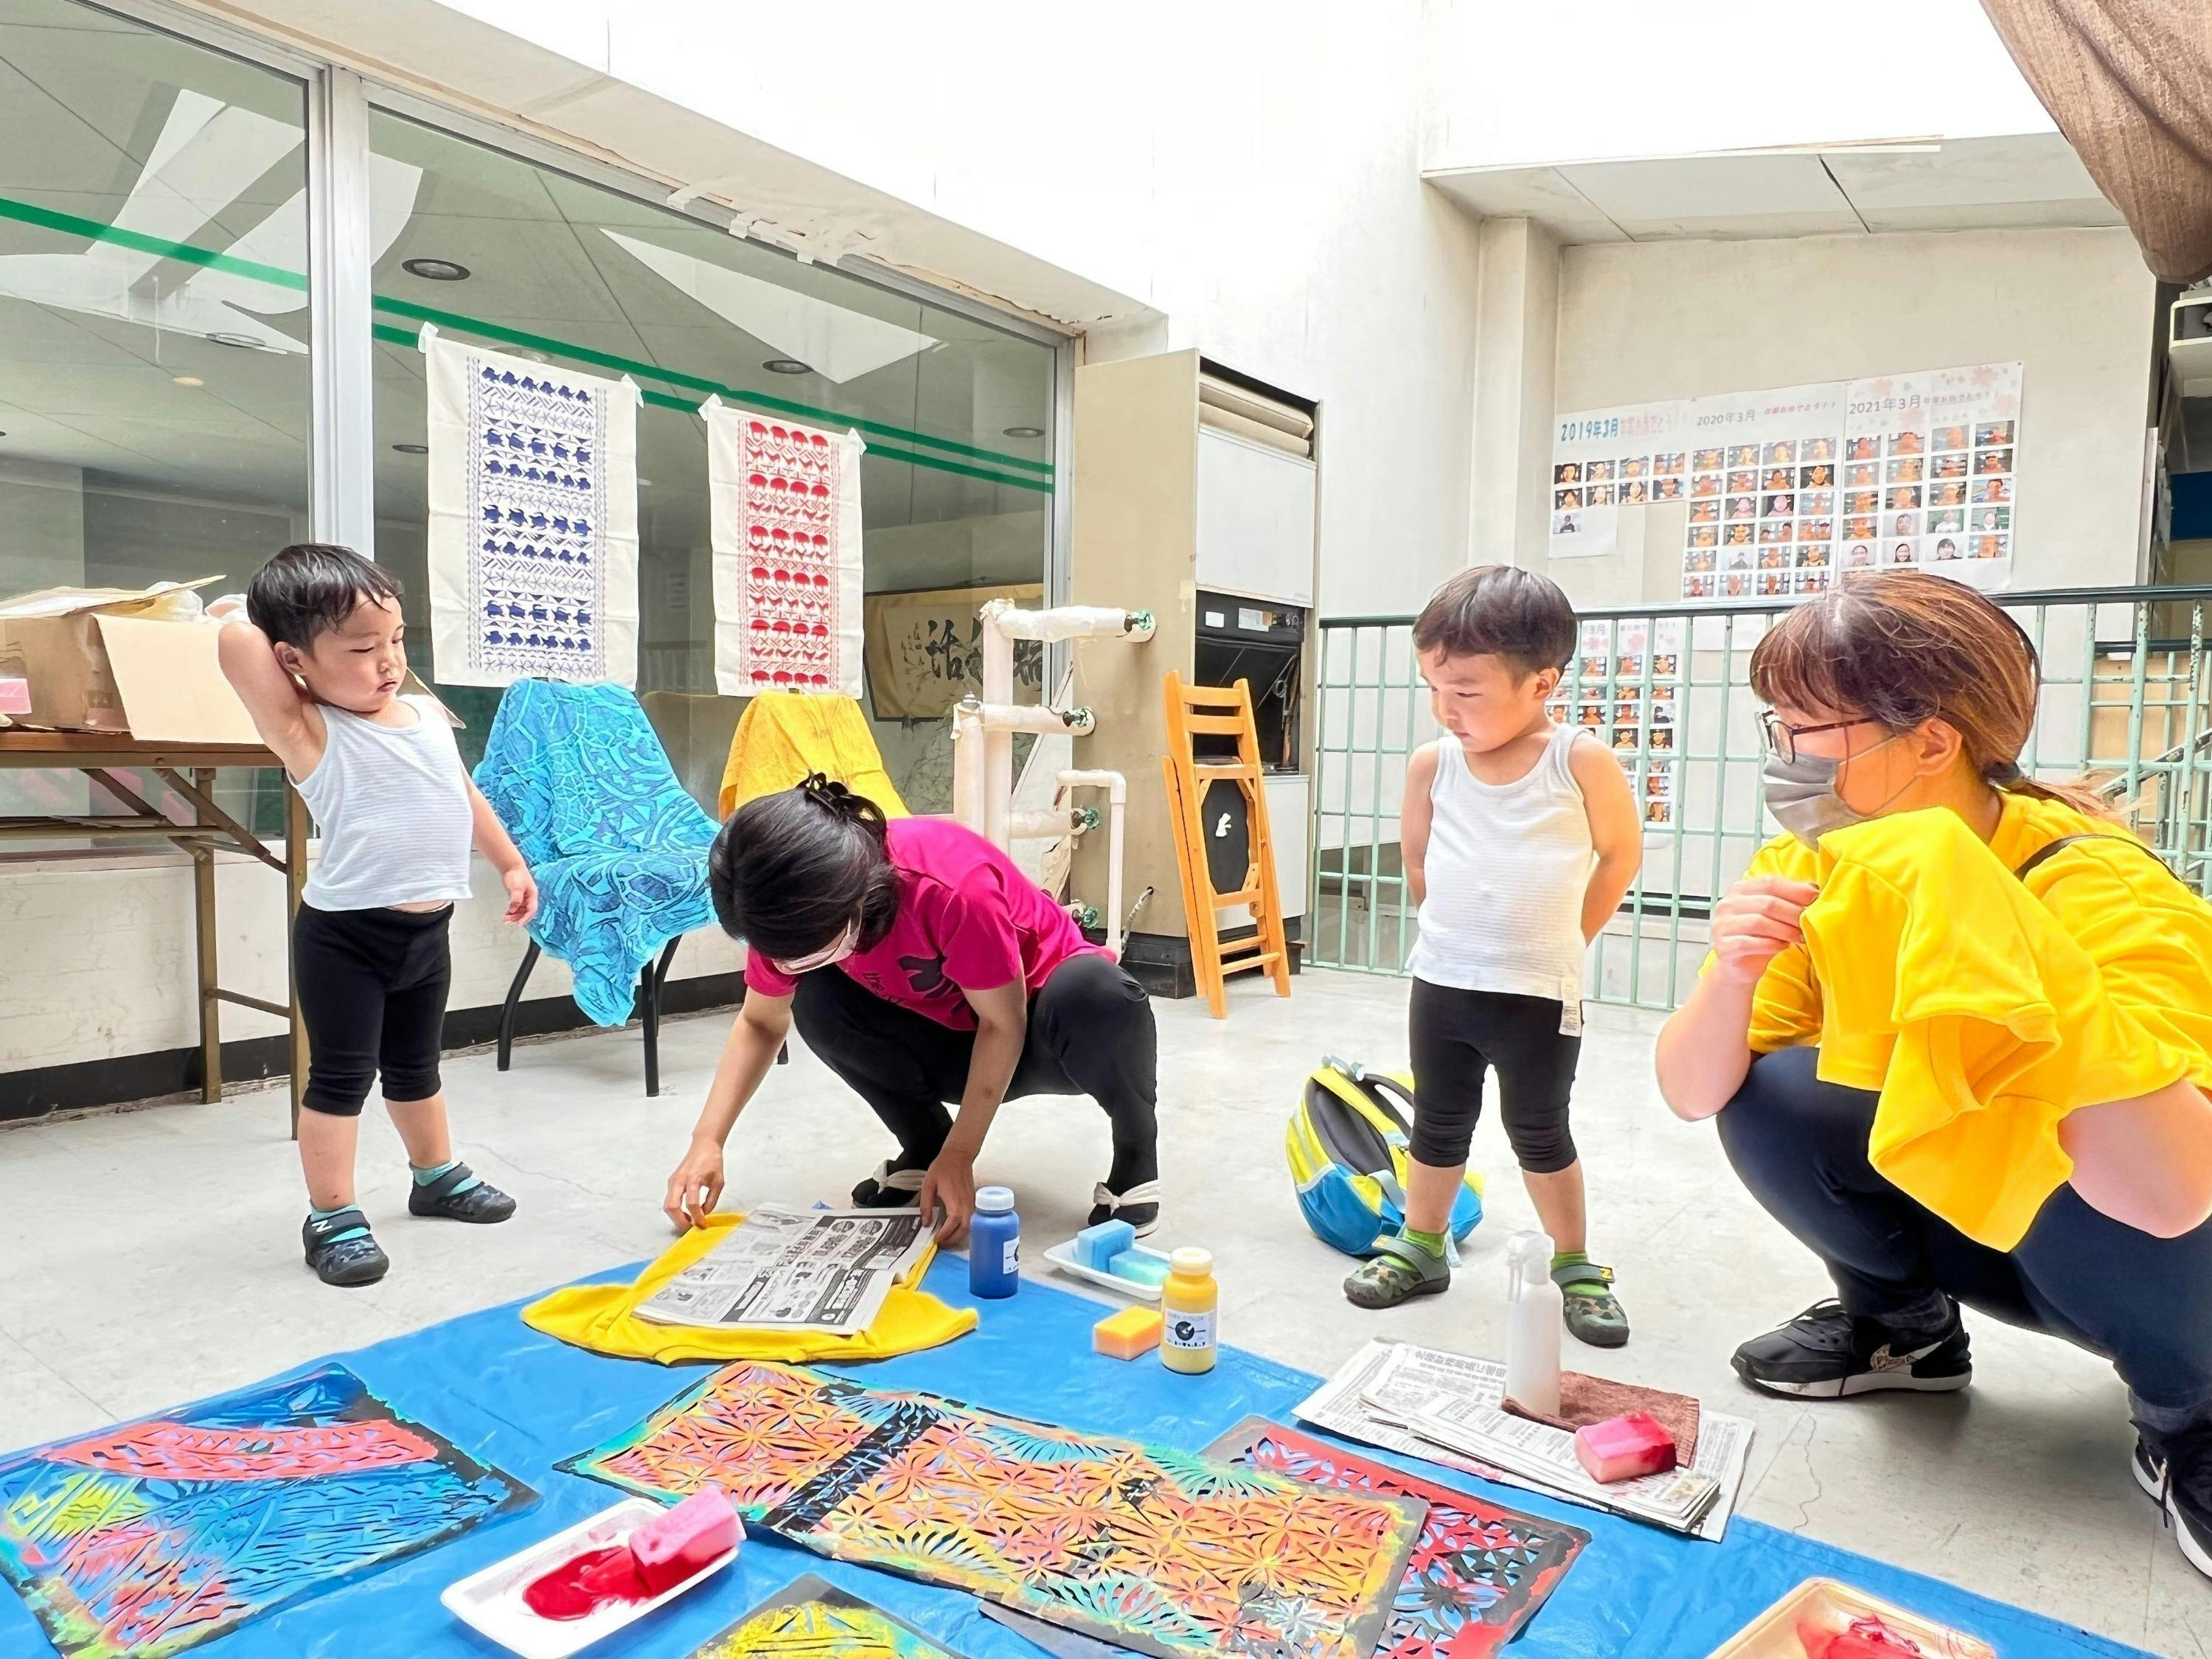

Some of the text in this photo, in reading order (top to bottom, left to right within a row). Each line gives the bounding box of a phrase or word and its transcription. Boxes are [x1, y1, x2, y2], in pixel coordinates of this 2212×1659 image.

[1849, 395, 1920, 414] 2021年3月
[1697, 409, 1755, 426] 2020年3月
[1561, 417, 1618, 442] 2019年3月
